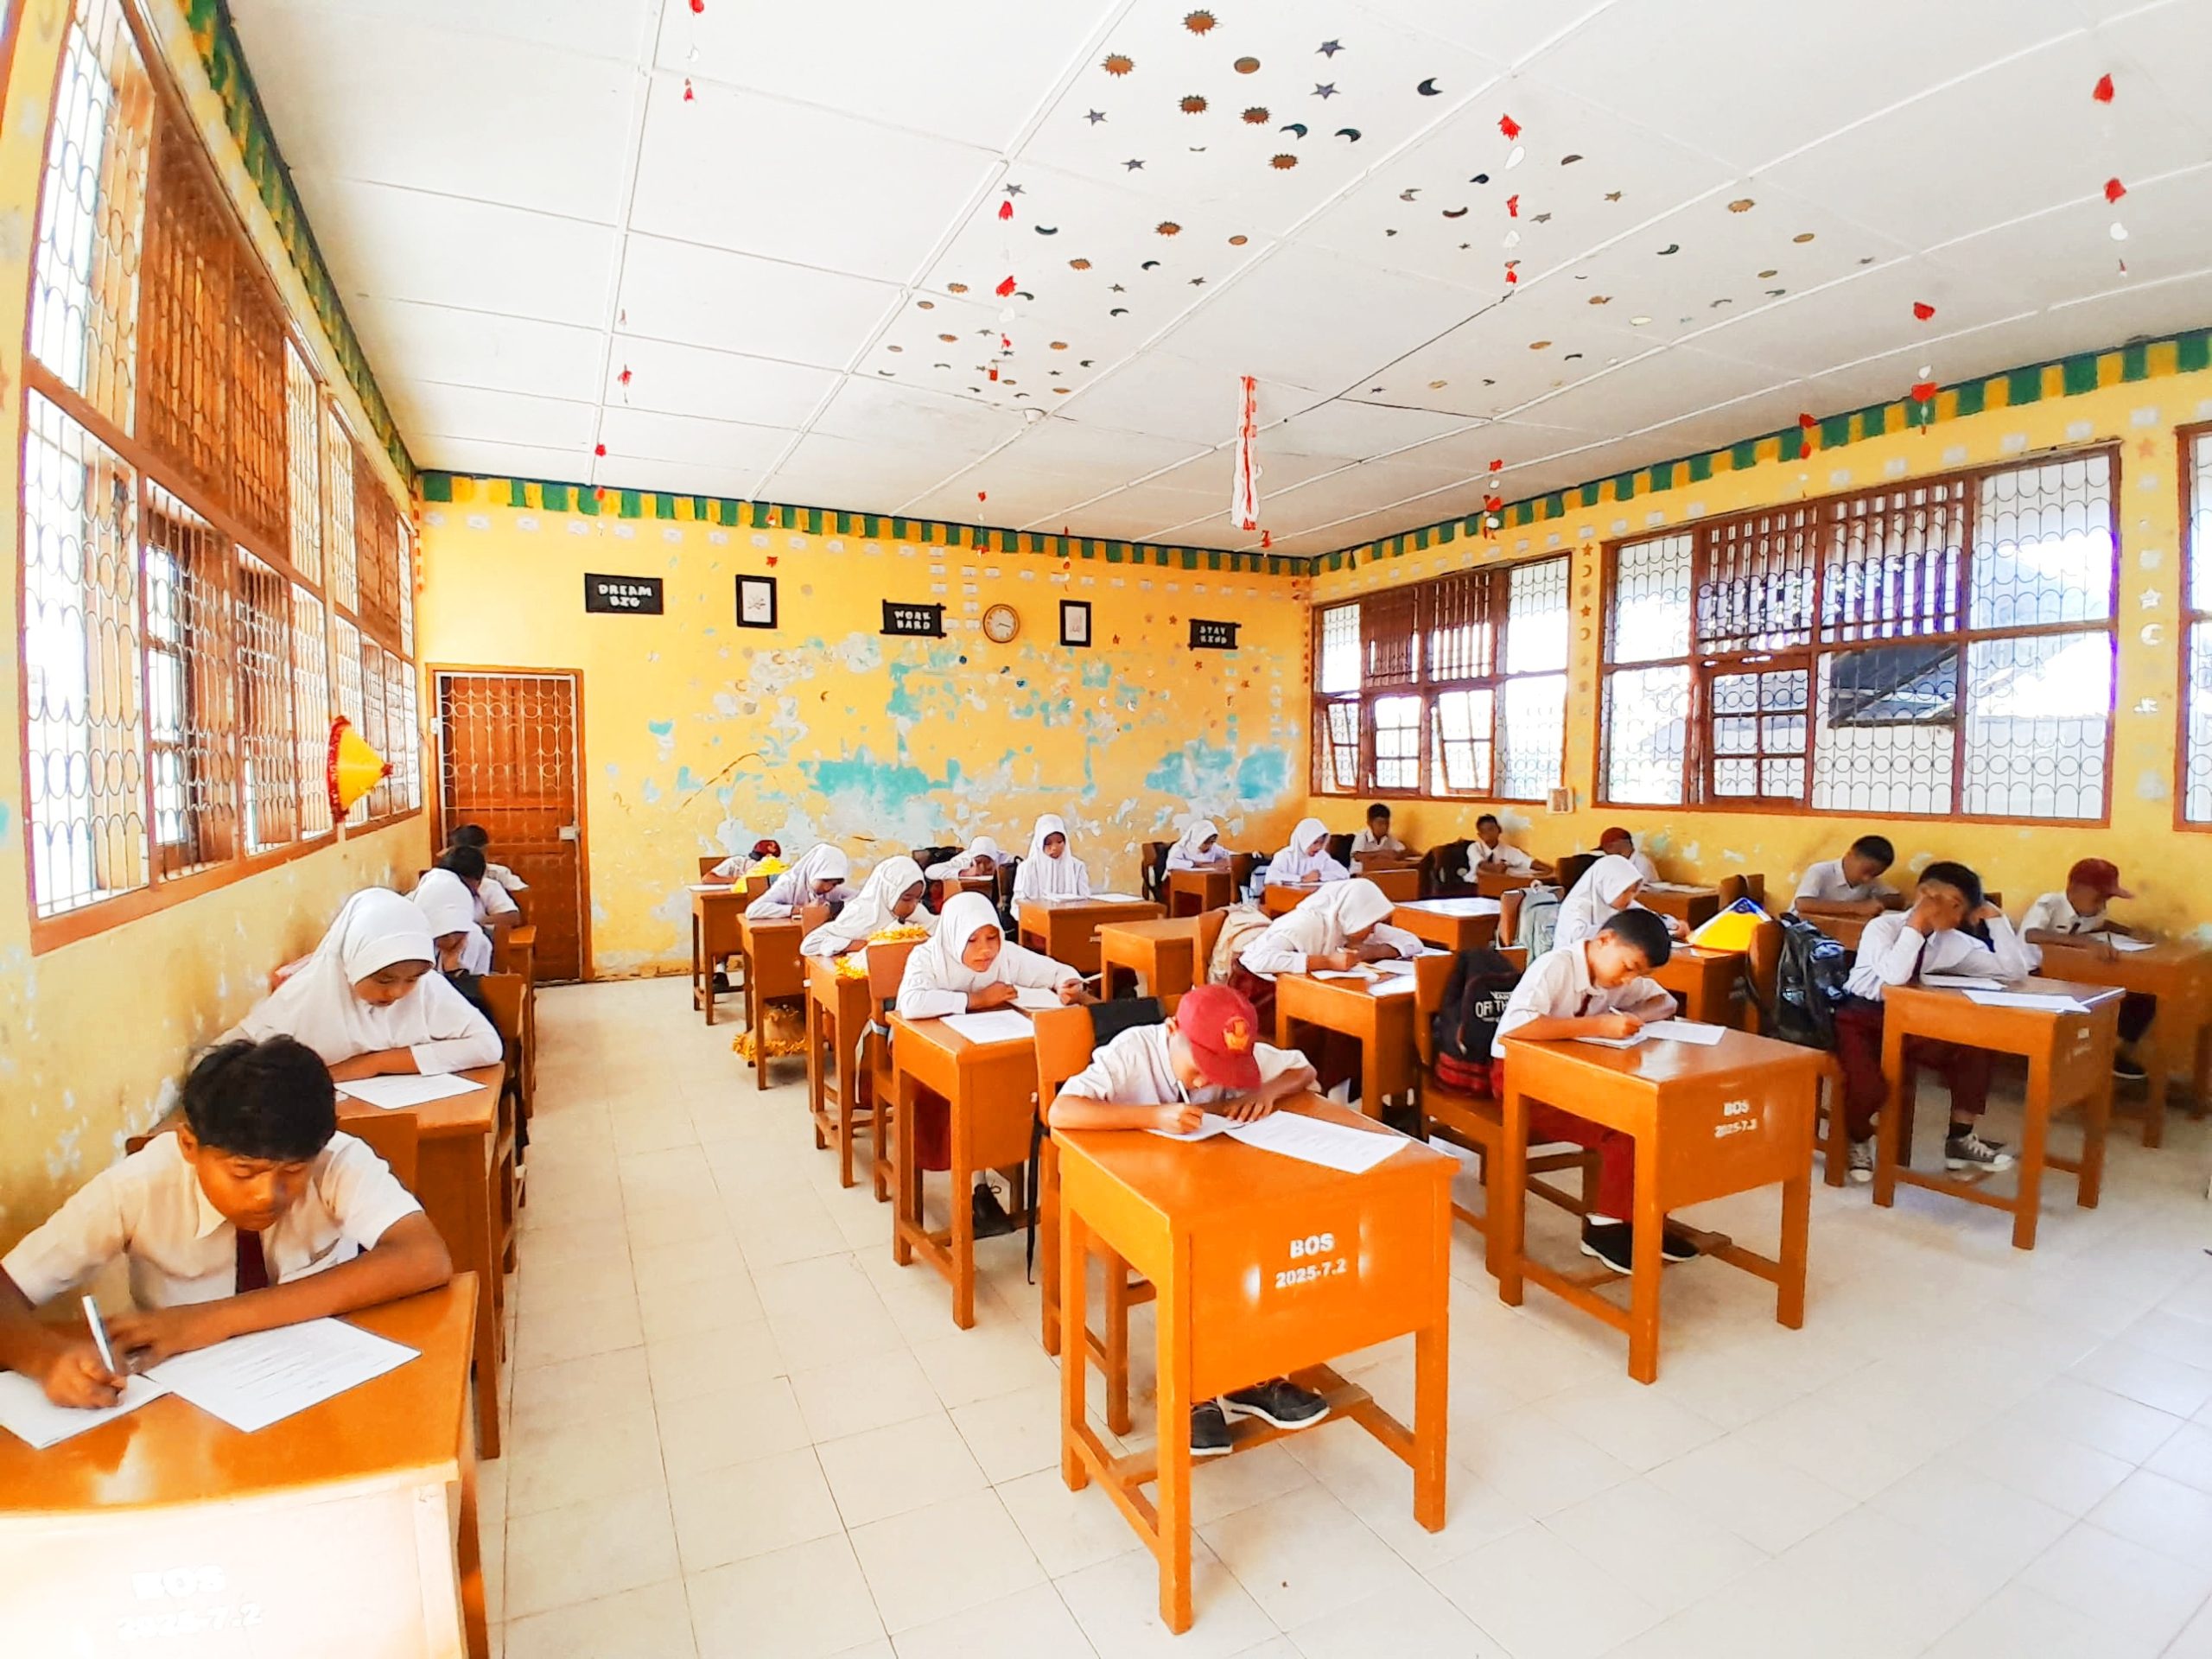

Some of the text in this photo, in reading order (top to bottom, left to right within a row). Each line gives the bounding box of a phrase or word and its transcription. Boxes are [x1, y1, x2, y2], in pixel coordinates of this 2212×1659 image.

[598, 584, 652, 596] DREAM
[609, 595, 640, 607] BIG
[894, 610, 931, 620] WORK
[896, 620, 931, 630] HARD
[1199, 626, 1225, 635] STAY
[1200, 635, 1227, 645] KIND
[1289, 1232, 1335, 1259] BOS
